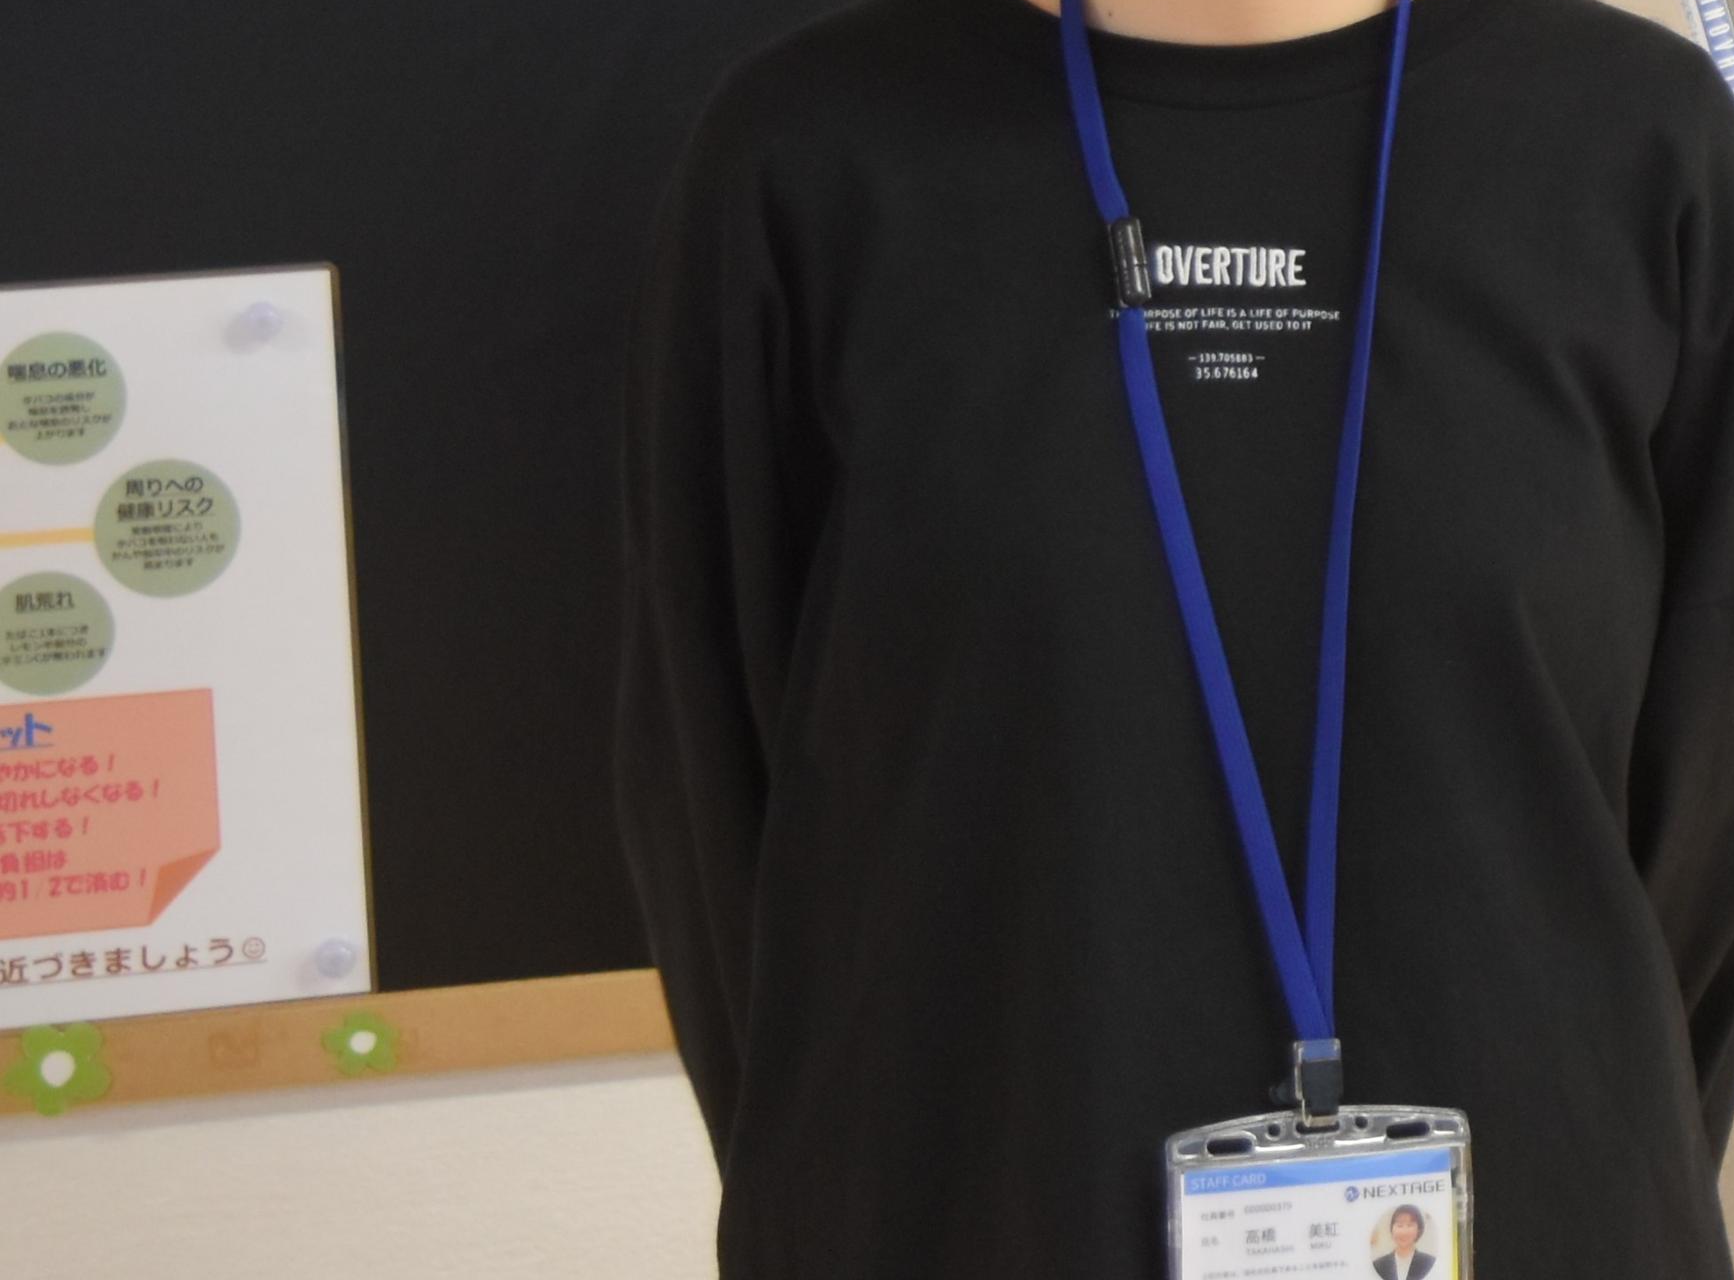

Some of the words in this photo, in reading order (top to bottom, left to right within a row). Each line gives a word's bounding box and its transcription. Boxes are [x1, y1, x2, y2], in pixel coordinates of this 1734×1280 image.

[1156, 245, 1306, 287] OVERTURE
[1185, 308, 1198, 318] OF
[1201, 308, 1223, 318] LIFE
[1227, 309, 1236, 318] IS
[1240, 309, 1246, 318] A
[1249, 308, 1272, 318] LIFE
[1275, 309, 1289, 319] OF
[1292, 309, 1340, 320] PURPOSE
[1165, 321, 1175, 331] IS
[1178, 321, 1198, 330] NOT
[1232, 321, 1253, 330] GET
[1255, 321, 1283, 330] USED
[1287, 321, 1299, 330] TO
[1302, 321, 1312, 329] IT
[125, 476, 204, 497] 周りへの
[117, 497, 214, 521] 健康リスク
[15, 591, 74, 613] 肌荒れ
[1191, 1175, 1230, 1191] STAFF
[1233, 1173, 1267, 1187] CARD
[1362, 1180, 1445, 1199] NEXTAGE
